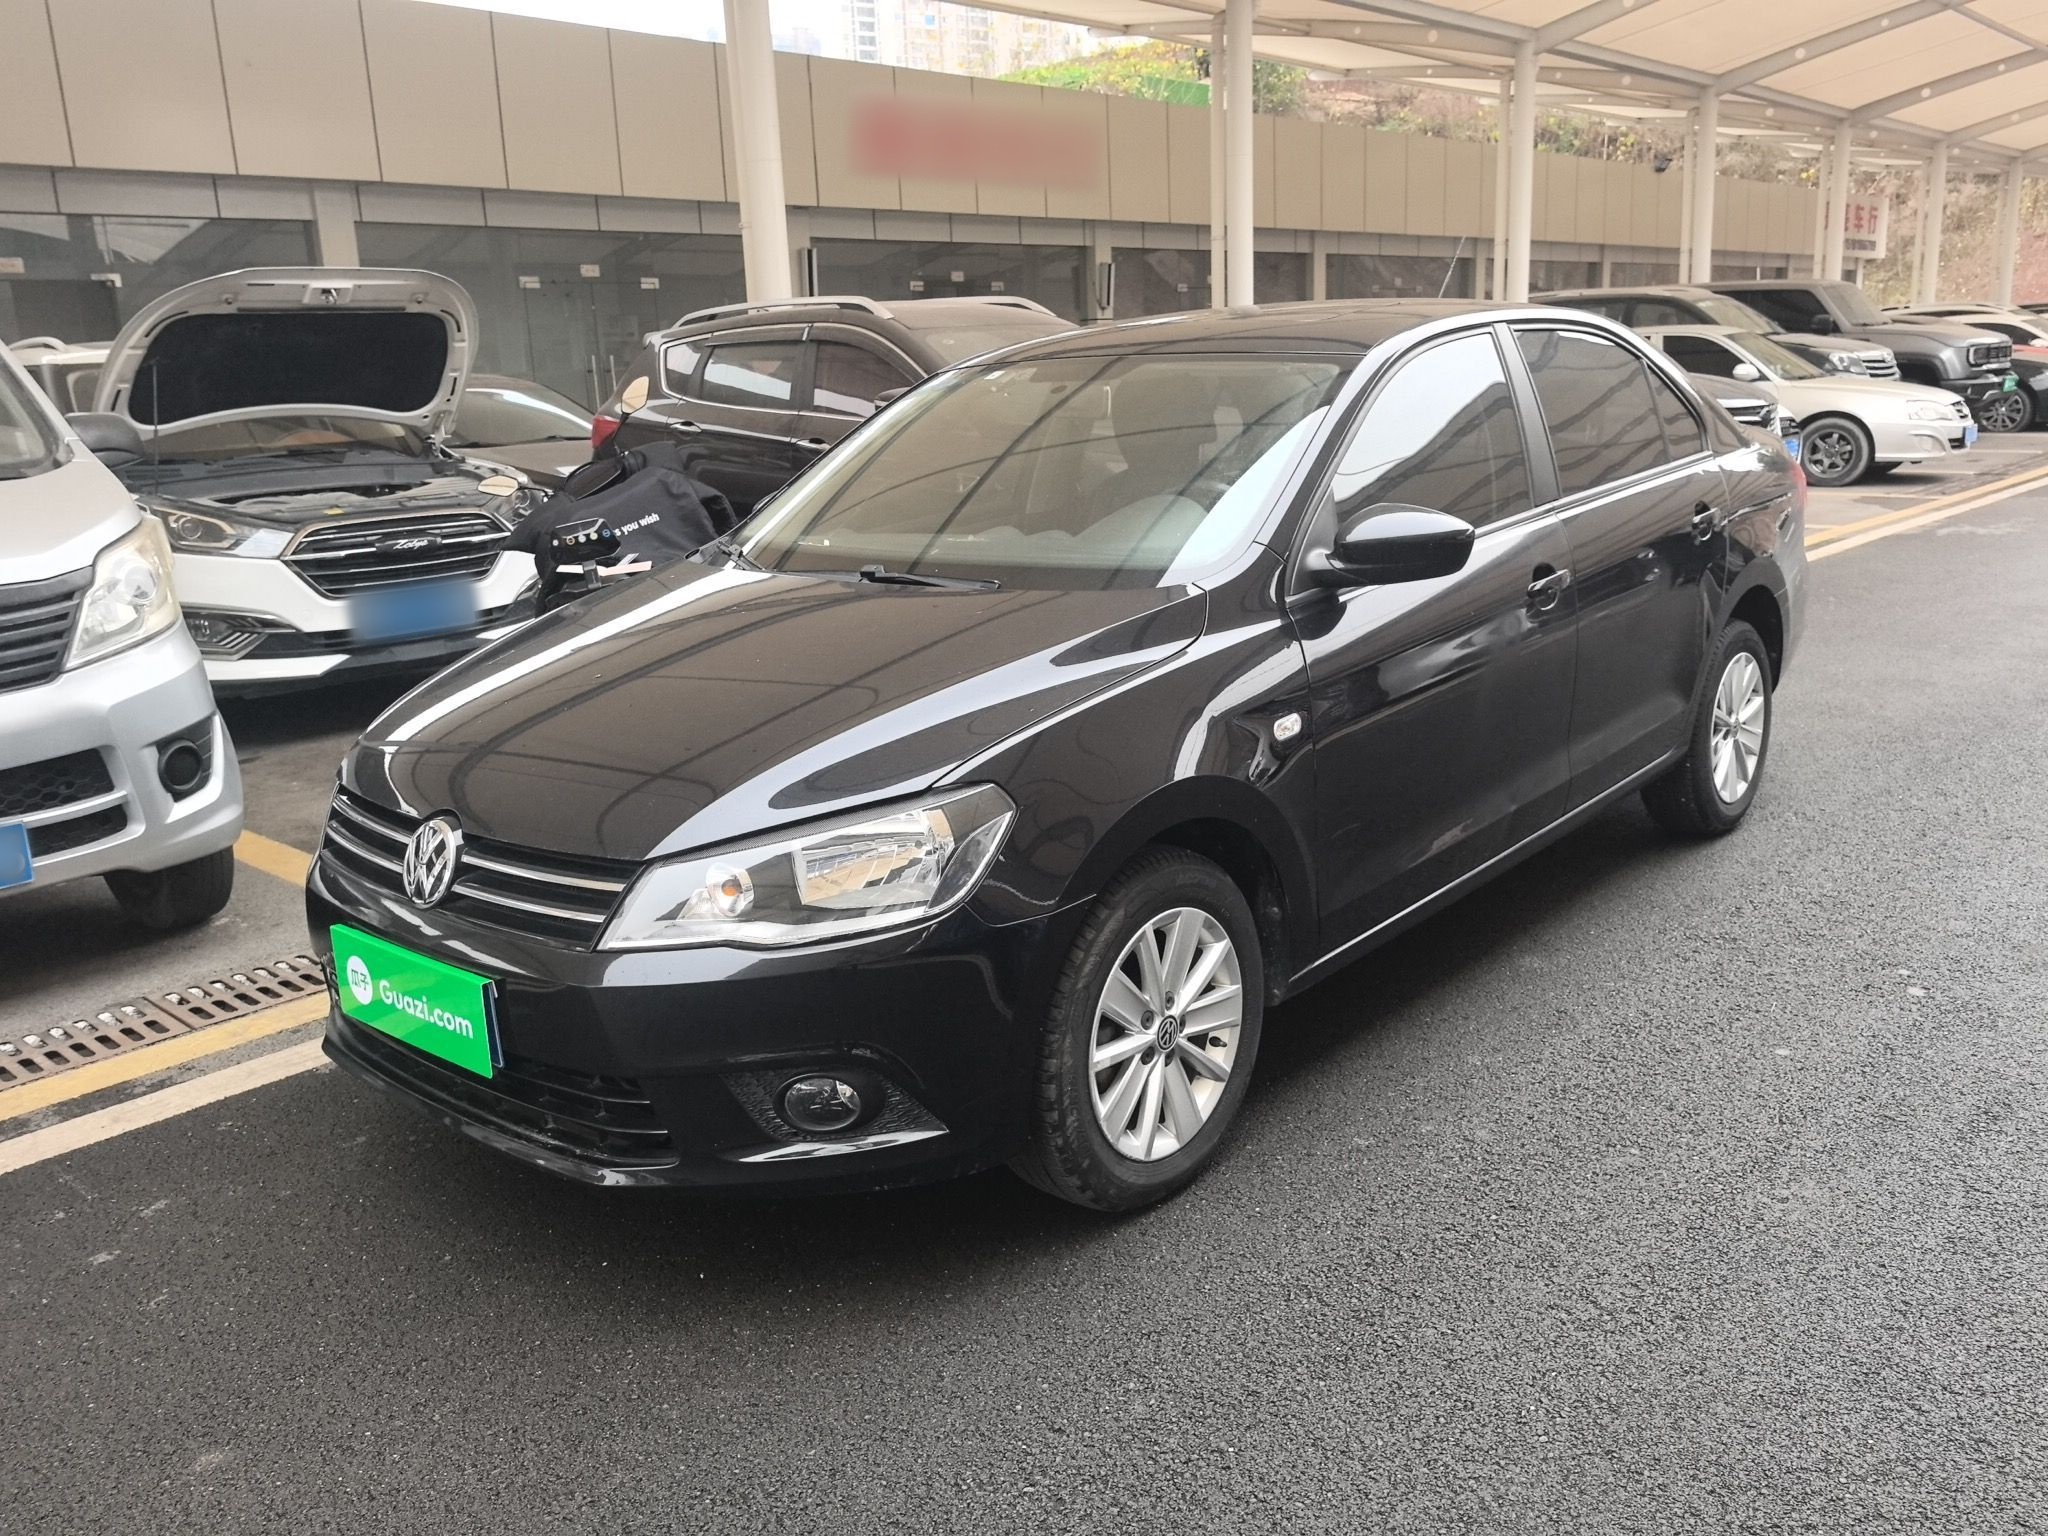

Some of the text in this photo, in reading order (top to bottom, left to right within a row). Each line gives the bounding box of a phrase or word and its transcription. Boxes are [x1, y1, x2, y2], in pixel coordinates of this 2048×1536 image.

[621, 521, 640, 535] you
[638, 512, 660, 527] wish
[351, 968, 369, 991] 瓜子
[379, 979, 474, 1039] Guazi.com
